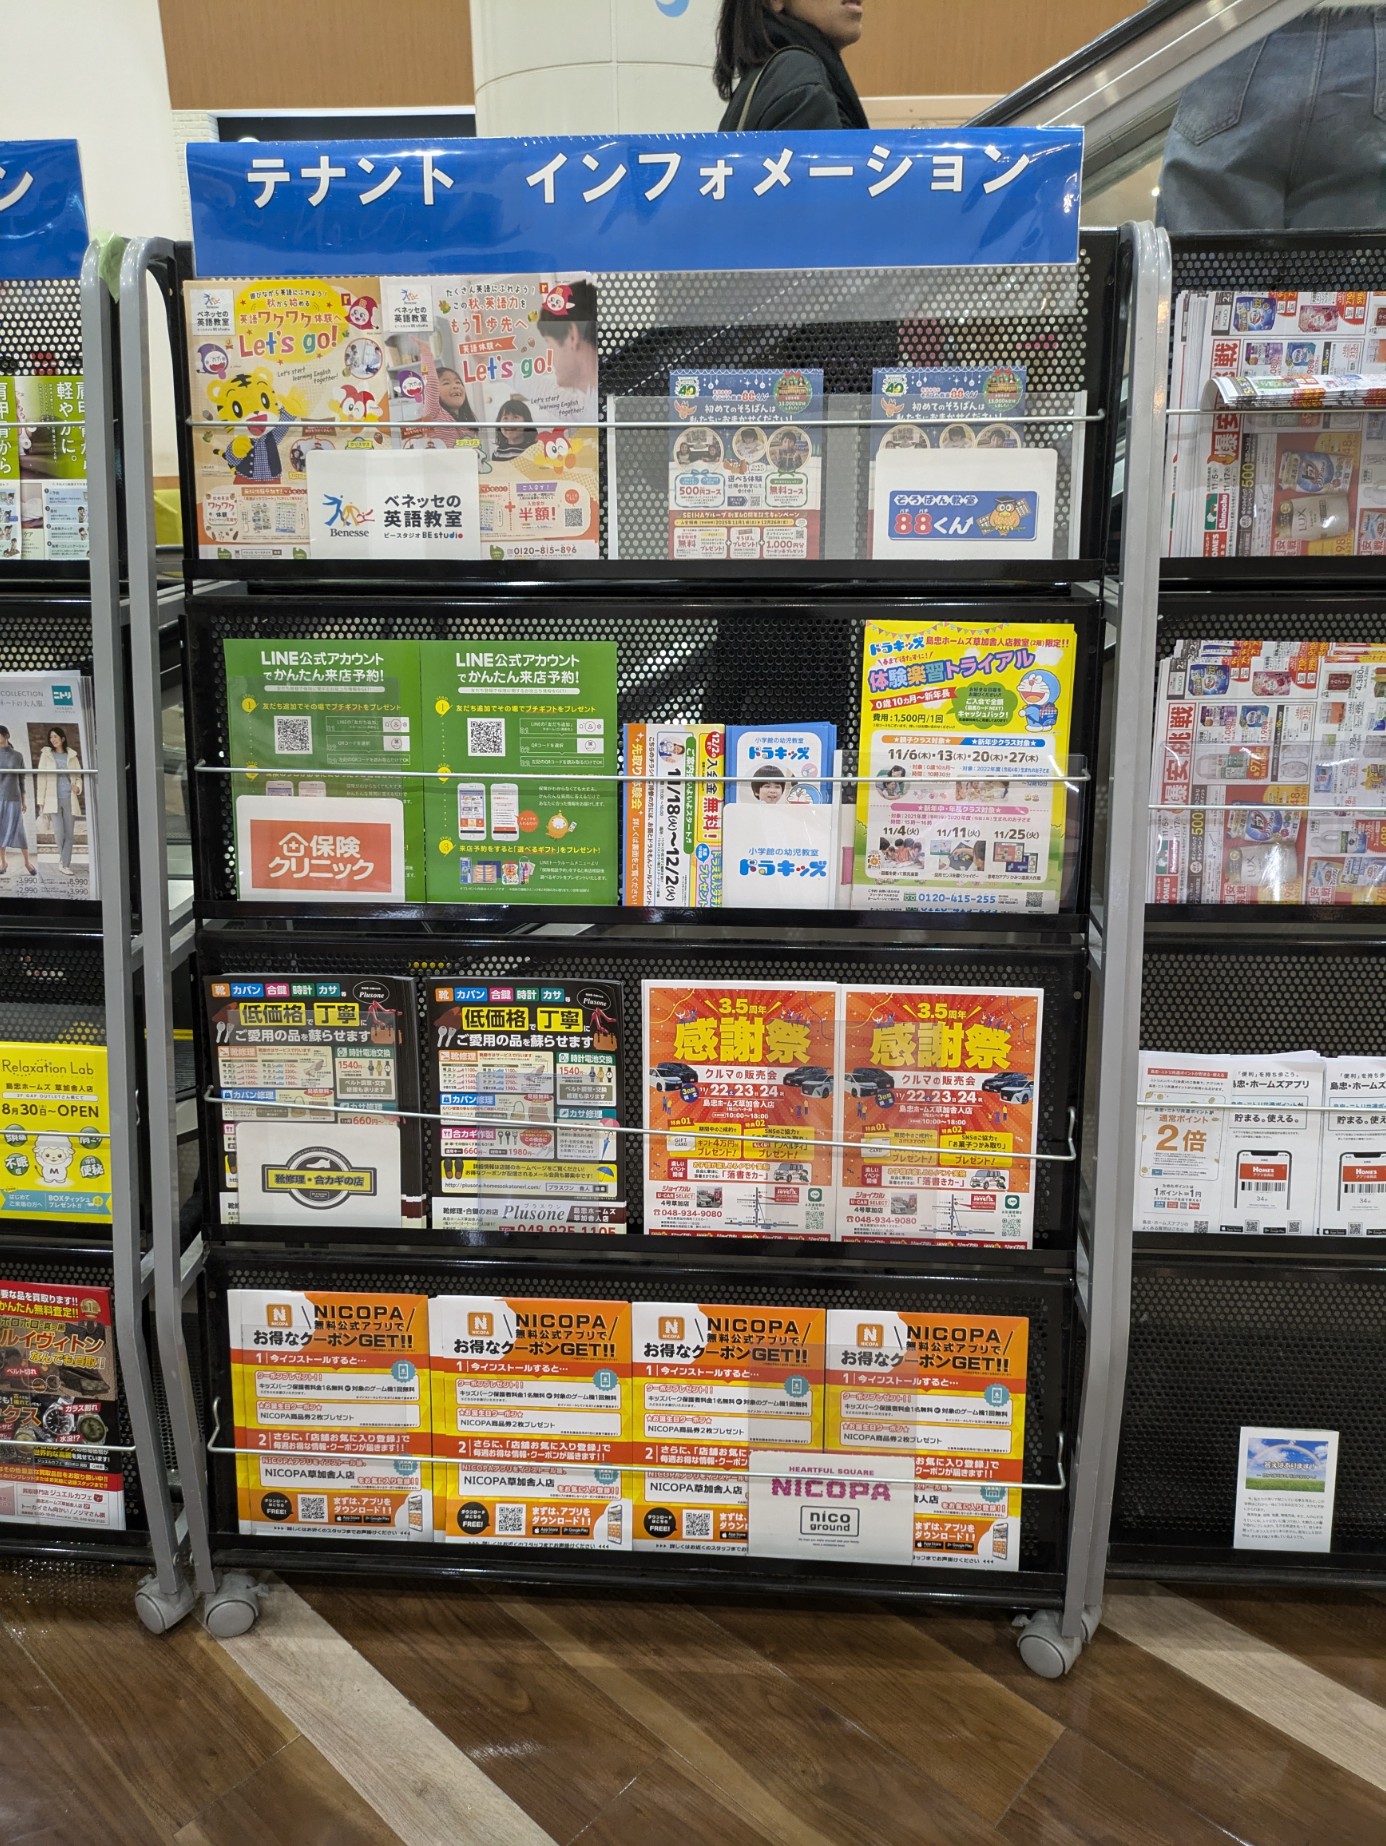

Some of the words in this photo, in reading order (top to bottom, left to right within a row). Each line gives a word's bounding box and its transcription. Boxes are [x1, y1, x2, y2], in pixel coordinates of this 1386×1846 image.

[248, 154, 455, 207] テナント
[525, 145, 1033, 204] インフォメーション
[267, 299, 310, 307] 秋から始める
[240, 311, 342, 328] 英語ワクワク体験へ
[394, 314, 428, 322] 英語教室
[451, 313, 528, 334] もう1歩先へ
[239, 329, 294, 358] Let's
[303, 326, 337, 353] go!
[463, 342, 502, 353] 英語体験へ
[463, 355, 513, 383] Let's
[521, 349, 552, 379] go!
[705, 404, 775, 413] 初めてのそろばんは
[1242, 464, 1255, 487] 500
[384, 494, 461, 508] ベネッセの
[894, 495, 978, 506] そろばん教室
[519, 507, 556, 521] 半額!
[1219, 494, 1228, 529] Shimachu
[384, 511, 462, 528] 英語教室
[895, 513, 973, 535] 88くん
[1297, 509, 1306, 532] LUX
[330, 529, 369, 537] Benesse
[514, 546, 577, 555] 0120-815-896
[870, 636, 925, 656] ドラキッズ
[261, 651, 384, 665] LINE公式アカウント
[456, 653, 579, 667] LINE公式アカウント
[263, 669, 384, 682] でかんたん来店予約!
[868, 649, 1036, 692] 体験楽習トライアル
[458, 671, 579, 684] でかんたん来店予約!
[54, 690, 72, 700] ニトリ
[749, 747, 810, 760] ドラキッズ
[888, 749, 1038, 762] 11/6(木)・13(木)・20(木)・27(木)
[1164, 704, 1193, 805] 爆安挑戦
[704, 797, 718, 839] 無料!
[1191, 813, 1203, 836] 500
[883, 826, 919, 836] 11/4(火)
[937, 827, 980, 837] 11/11(火)
[995, 829, 1039, 839] 11/25(火)
[310, 835, 360, 857] 保険
[749, 848, 819, 857] 小学館の幼児教室
[269, 857, 374, 880] クリニック
[740, 859, 827, 877] ドラキッズ
[1247, 856, 1256, 878] LUX
[919, 893, 995, 903] 0120-415-255
[215, 986, 226, 995] 靴
[233, 986, 261, 995] カバン
[267, 986, 288, 995] 合鍵
[292, 986, 312, 995] 時計
[319, 986, 337, 995] カサ
[438, 991, 449, 999] 靴
[457, 990, 485, 999] カバン
[517, 991, 537, 999] 時計
[543, 991, 561, 999] カサ
[719, 998, 766, 1013] 3.5周年
[917, 1003, 966, 1018] 3.5周年
[235, 1030, 370, 1042] ご愛用の品を蘇らせます
[457, 1034, 593, 1047] ご愛用の品を蘇らせます
[674, 1017, 811, 1064] 感謝祭
[870, 1021, 1011, 1069] 感謝祭
[571, 1054, 612, 1063] 時計電池交換
[2, 1060, 66, 1074] Relaxation
[71, 1062, 94, 1074] Lab
[706, 1069, 777, 1080] クルマの販売会
[902, 1075, 976, 1086] クルマの販売会
[55, 1084, 93, 1092] 草加舎人店
[452, 1096, 493, 1104] カバン修理
[569, 1110, 602, 1118] カサ修理
[899, 1105, 972, 1115] 島忠ホームズ草加舎人店
[1159, 1114, 1208, 1123] 通常ポイント
[1235, 1114, 1299, 1123] 貯まる。使える。
[1156, 1125, 1207, 1152] 2倍
[698, 1148, 737, 1156] プレゼント!
[5, 1156, 28, 1168] 不眠
[80, 1163, 104, 1176] 便秘
[722, 1170, 769, 1179] 「落書きカー」
[275, 1174, 364, 1186] 靴修理・合カギの店
[917, 1176, 965, 1187] 「落書きカー」
[502, 1205, 565, 1221] Plusone
[315, 1306, 403, 1320] NICOPA
[315, 1322, 404, 1331] 無料公式アプリで
[516, 1314, 606, 1328] NICOPA
[708, 1318, 798, 1334] NICOPA
[0, 1329, 104, 1353] ルイヴィトン
[254, 1331, 412, 1348] お得なクーポンGET!!
[516, 1330, 607, 1340] 無料公式アプリで
[707, 1334, 799, 1345] 無料公式アプリで
[454, 1340, 615, 1357] お得なクーポンGET!!
[644, 1343, 807, 1363] お得なクーポンGET!!
[907, 1342, 1000, 1354] 無料公式アプリで
[256, 1353, 261, 1362] 1
[841, 1351, 1009, 1372] お得なクーポンGET!!
[65, 1405, 98, 1413] ガラス割れ
[258, 1435, 266, 1445] 2
[274, 1433, 410, 1443] さらに、「店舗お気に入り登録」で
[458, 1442, 466, 1453] 2
[265, 1469, 355, 1480] NICOPA草加舎人店
[789, 1466, 834, 1474] HEARTFUL
[837, 1468, 874, 1476] SQUARE
[464, 1477, 554, 1487] NICOPA草加舎人店
[650, 1482, 742, 1494] NICOPA草加舎人店
[50, 1490, 93, 1500] ジュエルカフェ
[771, 1479, 891, 1501] NICOPA
[810, 1511, 850, 1523] nico
[810, 1522, 850, 1532] ground
